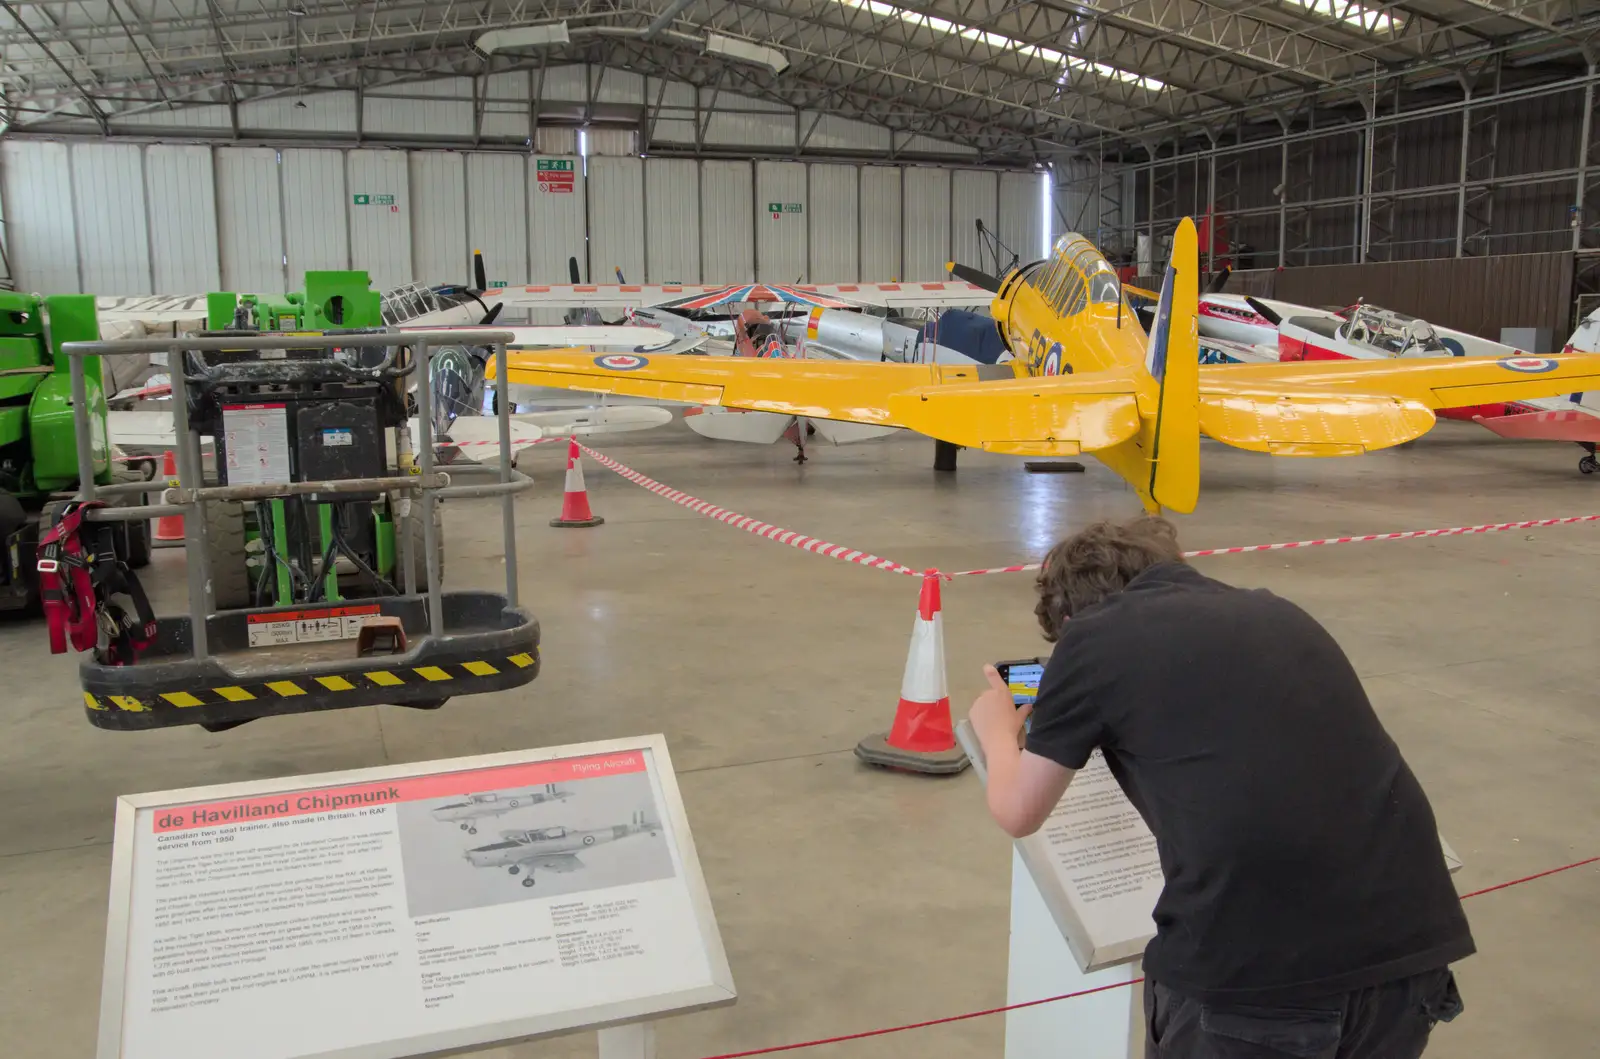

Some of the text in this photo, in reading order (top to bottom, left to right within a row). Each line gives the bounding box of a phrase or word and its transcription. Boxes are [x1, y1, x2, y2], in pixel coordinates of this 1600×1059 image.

[572, 756, 636, 774] Flying Aircraft
[159, 787, 401, 829] de Havilland Chipmunk
[158, 832, 199, 843] Canadian
[201, 829, 217, 838] two
[220, 827, 238, 836] seat
[272, 819, 289, 828] also
[292, 816, 315, 826] made
[318, 814, 325, 822] in
[369, 806, 387, 815] RAF
[158, 835, 235, 851] service from 1950
